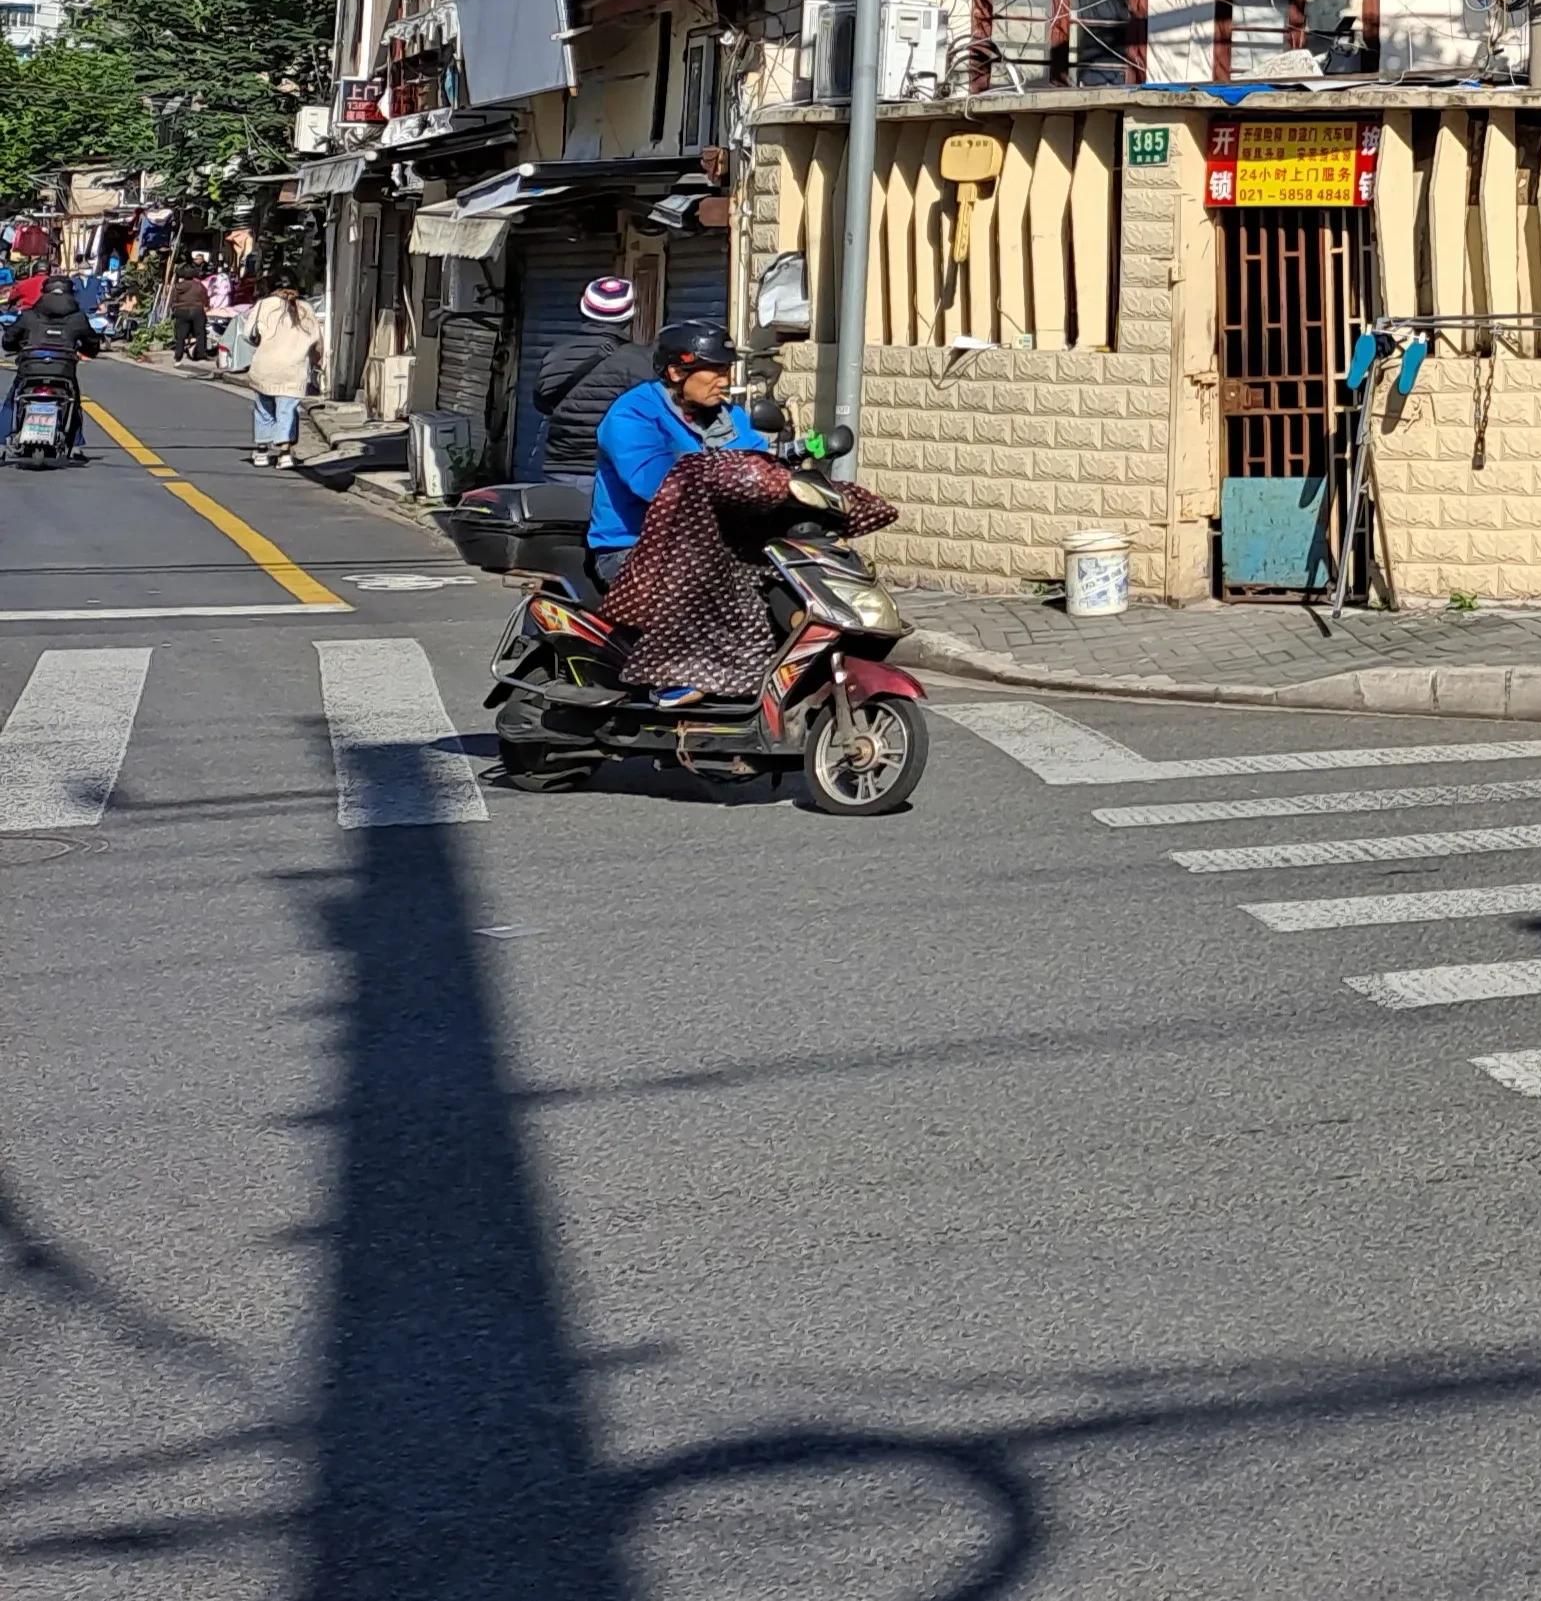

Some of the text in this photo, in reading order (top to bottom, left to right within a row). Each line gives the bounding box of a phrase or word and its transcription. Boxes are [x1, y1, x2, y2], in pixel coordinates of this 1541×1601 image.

[1133, 132, 1164, 152] 385
[1210, 128, 1235, 200] 开锁
[1240, 167, 1351, 183] 24小时上门服务
